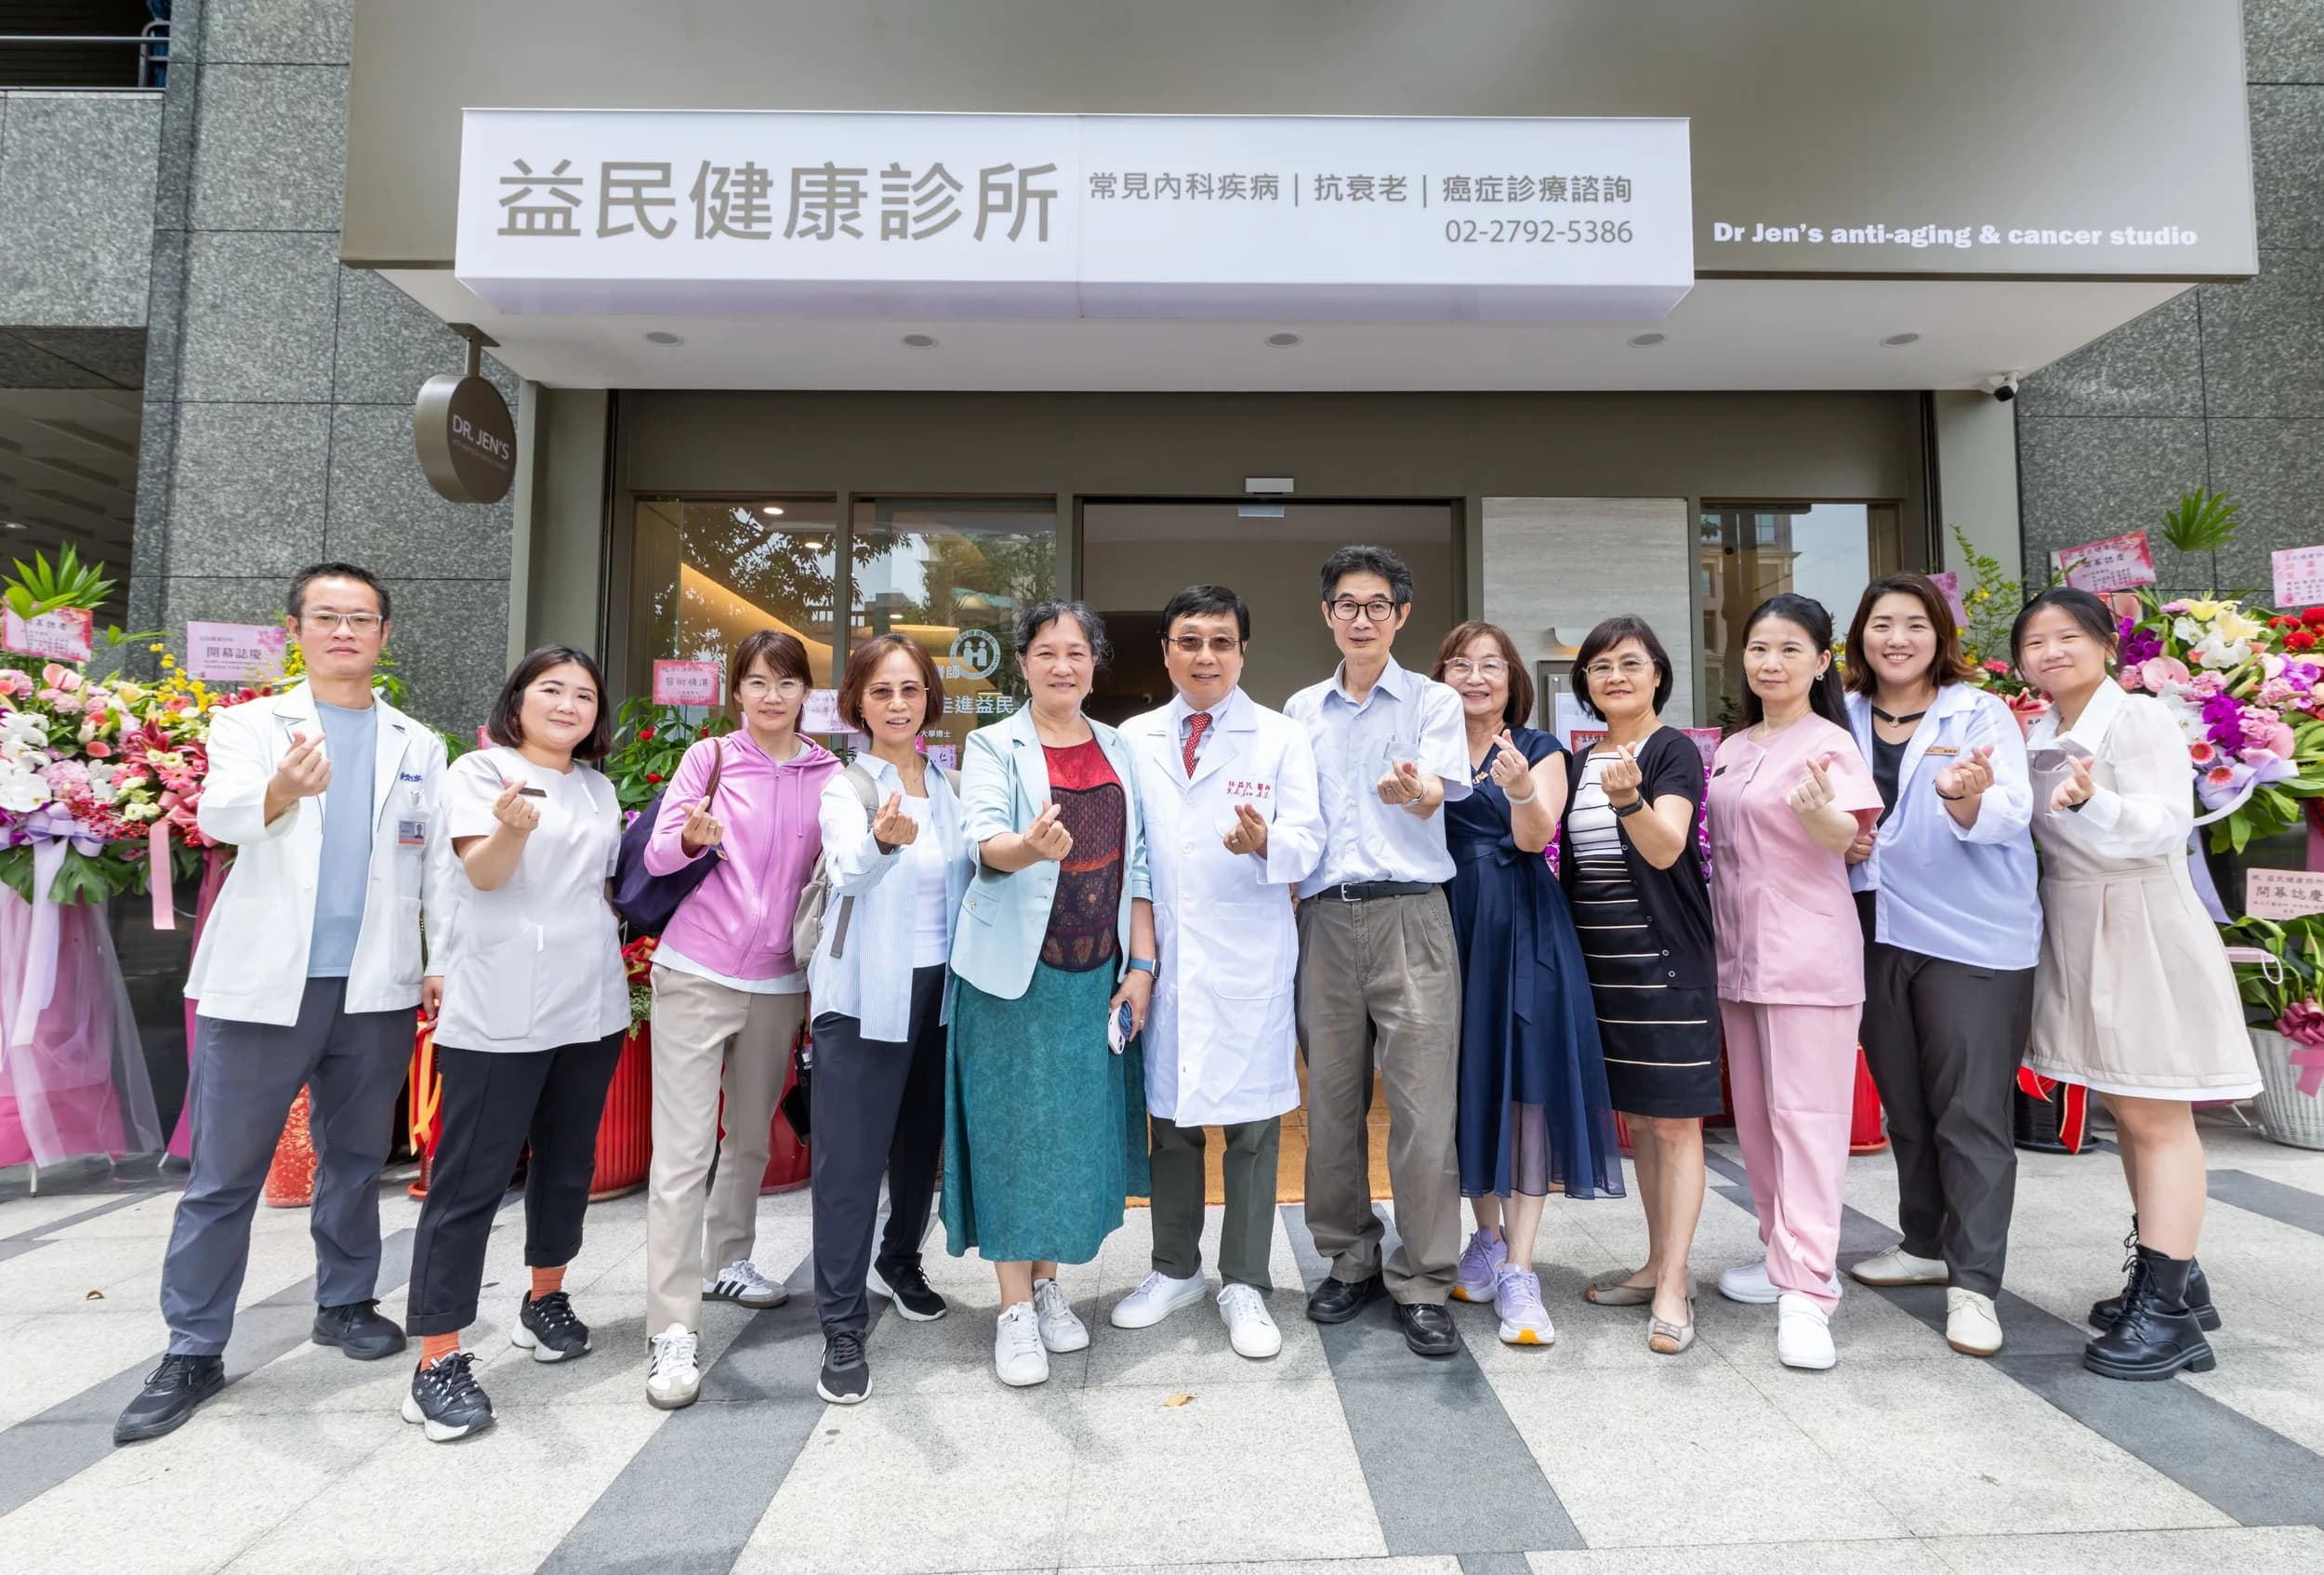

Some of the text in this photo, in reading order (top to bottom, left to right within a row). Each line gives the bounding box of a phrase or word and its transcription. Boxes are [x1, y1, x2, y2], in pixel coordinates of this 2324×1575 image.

[497, 158, 1059, 243] 益民健康診所
[1089, 171, 1633, 205] 常見內科疾病 抗衰老 癌症診療諮詢
[1445, 218, 1634, 244] 02-2792-5386
[1713, 222, 2198, 248] Dr Jen's anti-aging & cancer studio
[452, 414, 474, 442] DR.
[476, 429, 509, 460] JEN'S
[27, 618, 67, 630] 幕誌慶
[206, 646, 261, 660] 開幕誌慶
[2256, 885, 2324, 902] 開幕誌慶
